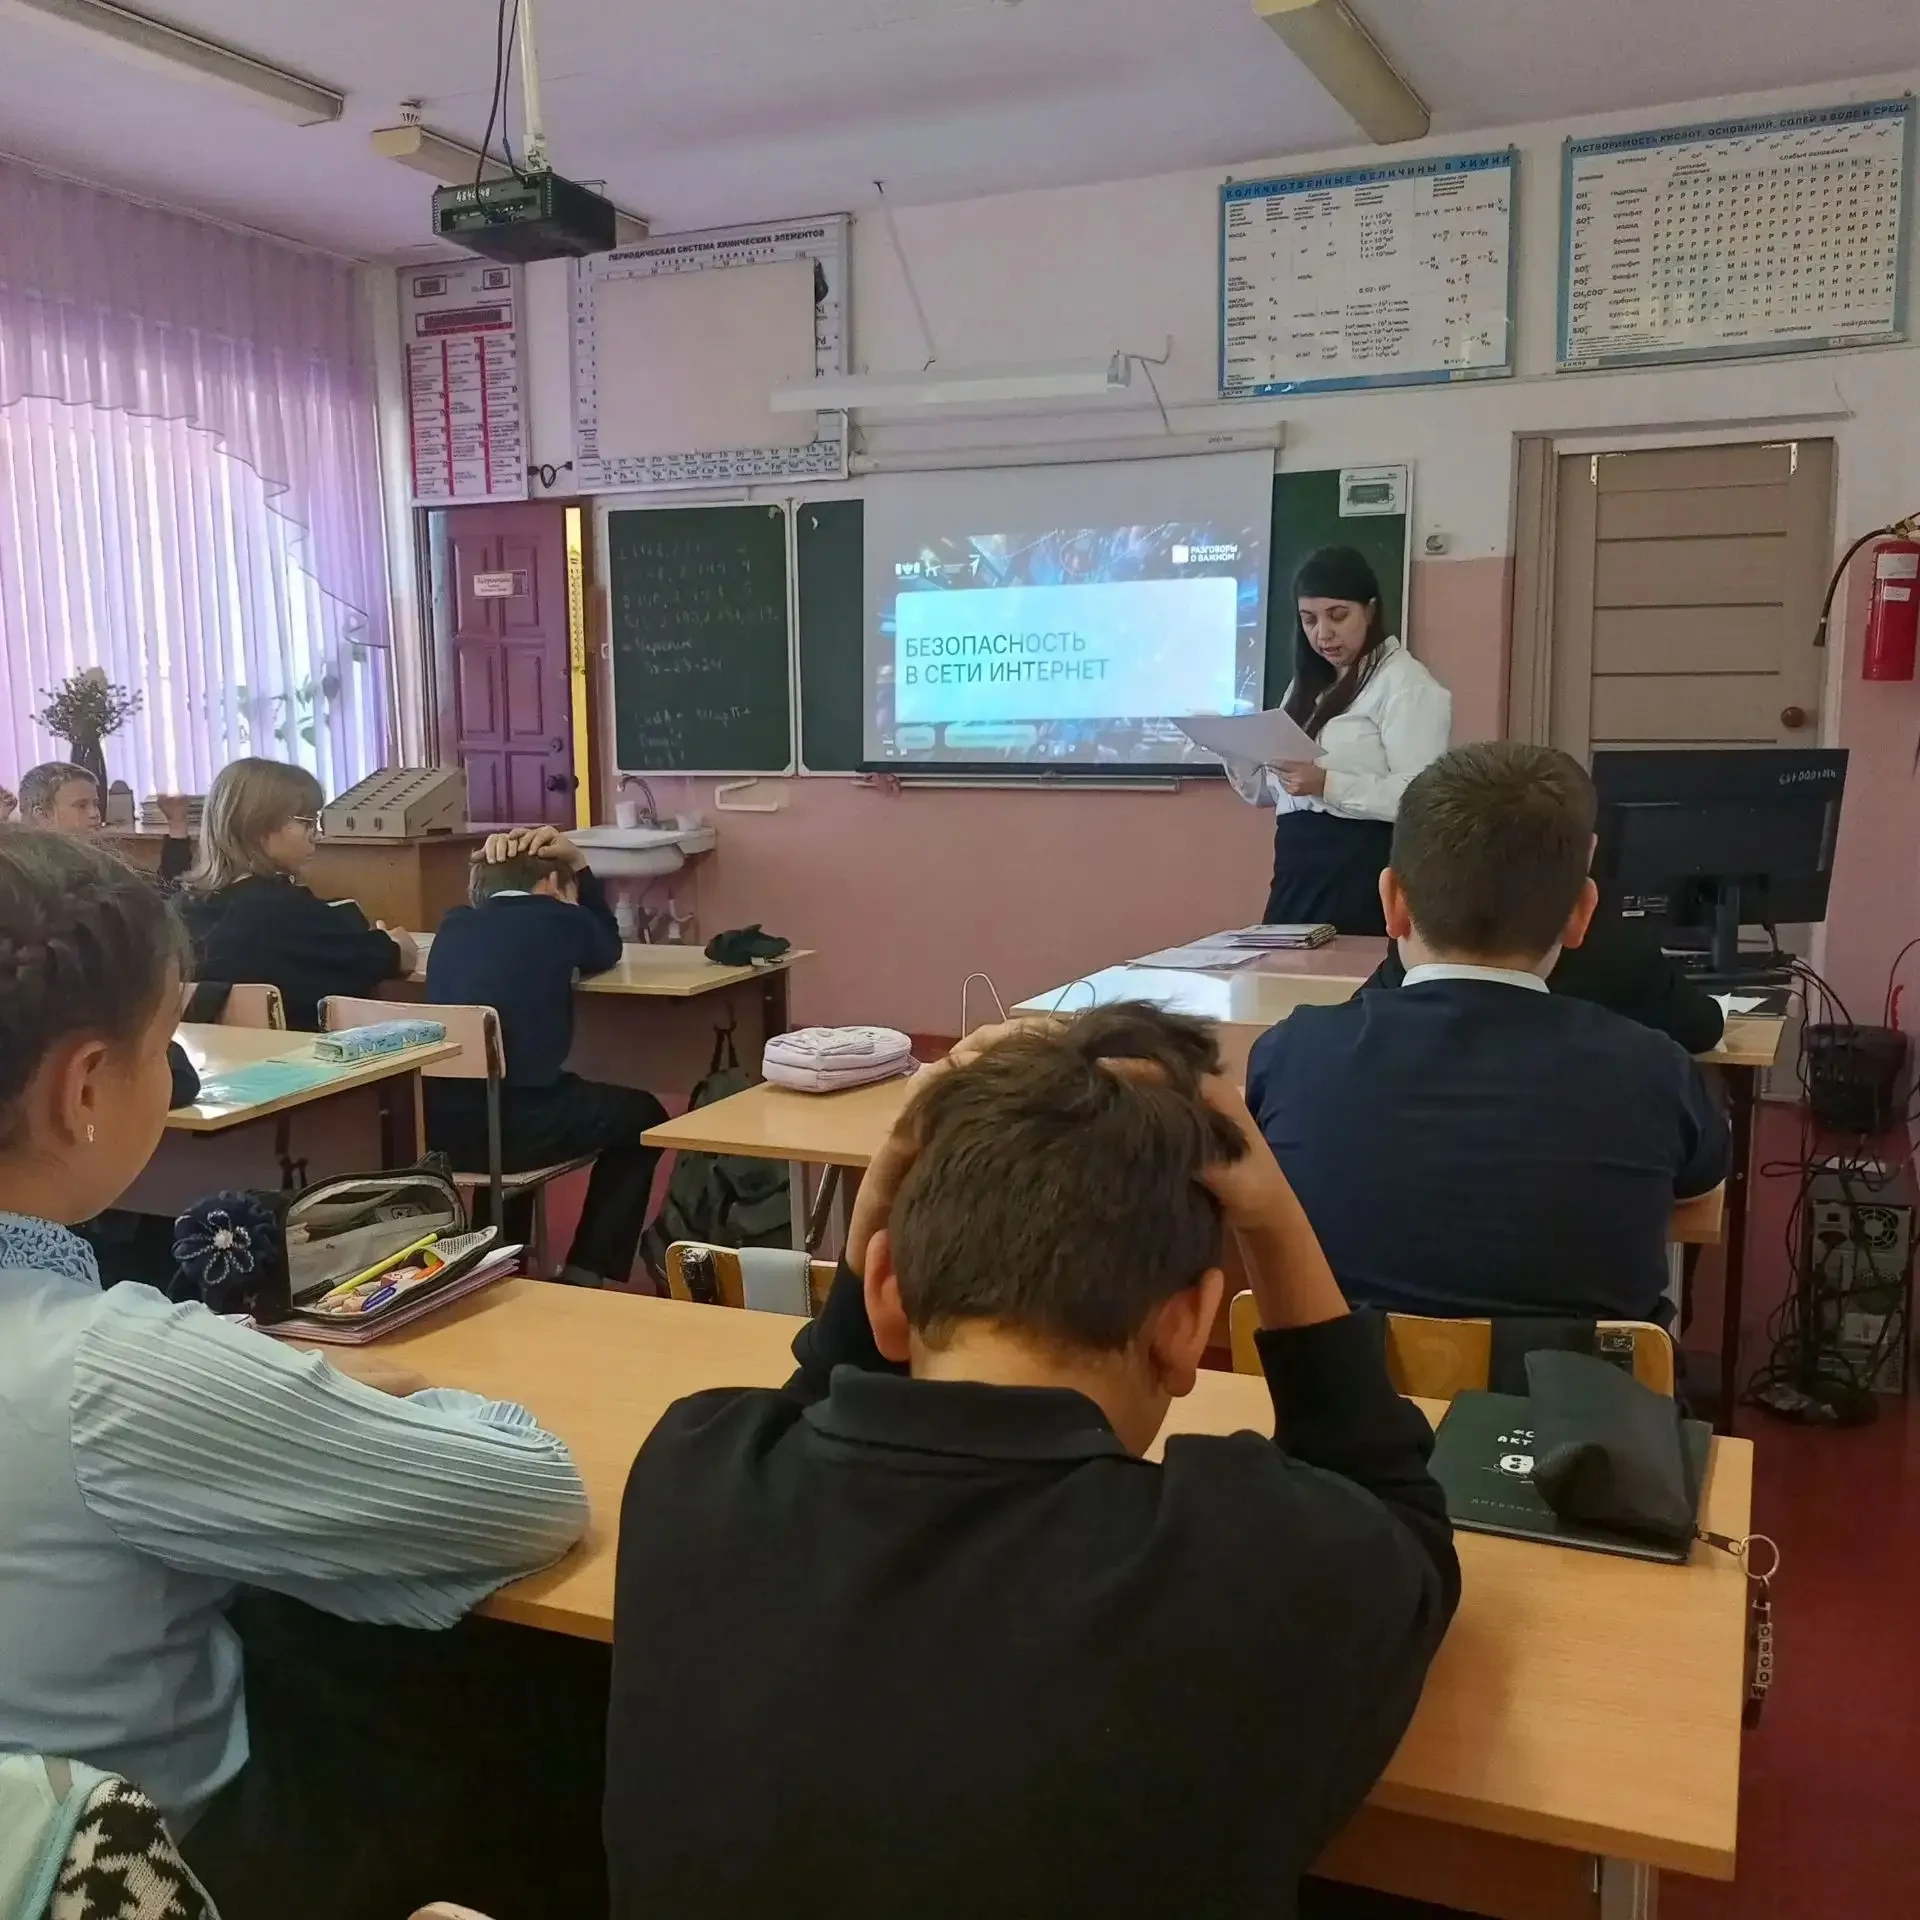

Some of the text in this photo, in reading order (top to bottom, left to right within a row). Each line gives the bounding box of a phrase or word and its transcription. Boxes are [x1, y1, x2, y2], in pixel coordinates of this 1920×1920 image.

[1570, 137, 1657, 154] РАСТВОРИМОСТЬ
[1780, 115, 1816, 128] СОЛЕЙ
[1830, 110, 1861, 121] ВОДЕ
[1874, 103, 1910, 116] СРЕДА
[1226, 175, 1352, 198] КОЛИЧЕСТВЕННЫЕ
[1360, 164, 1436, 181] ВЕЛИЧИНЫ
[1460, 156, 1511, 168] ХИМИИ
[608, 229, 825, 262] ПЕРИОДИЧЕСКАЯ СИСТЕМА ХИМИЧЕСКИХ ЭЛЕМЕНТОВ
[1191, 544, 1238, 554] РАЗГОВОРЫ
[1198, 553, 1235, 562] ВАЖНОМ
[906, 632, 1086, 657] БЕЗОПАСНОСТЬ
[906, 659, 1109, 684] В СЕТИ ИНТЕРНЕТ
